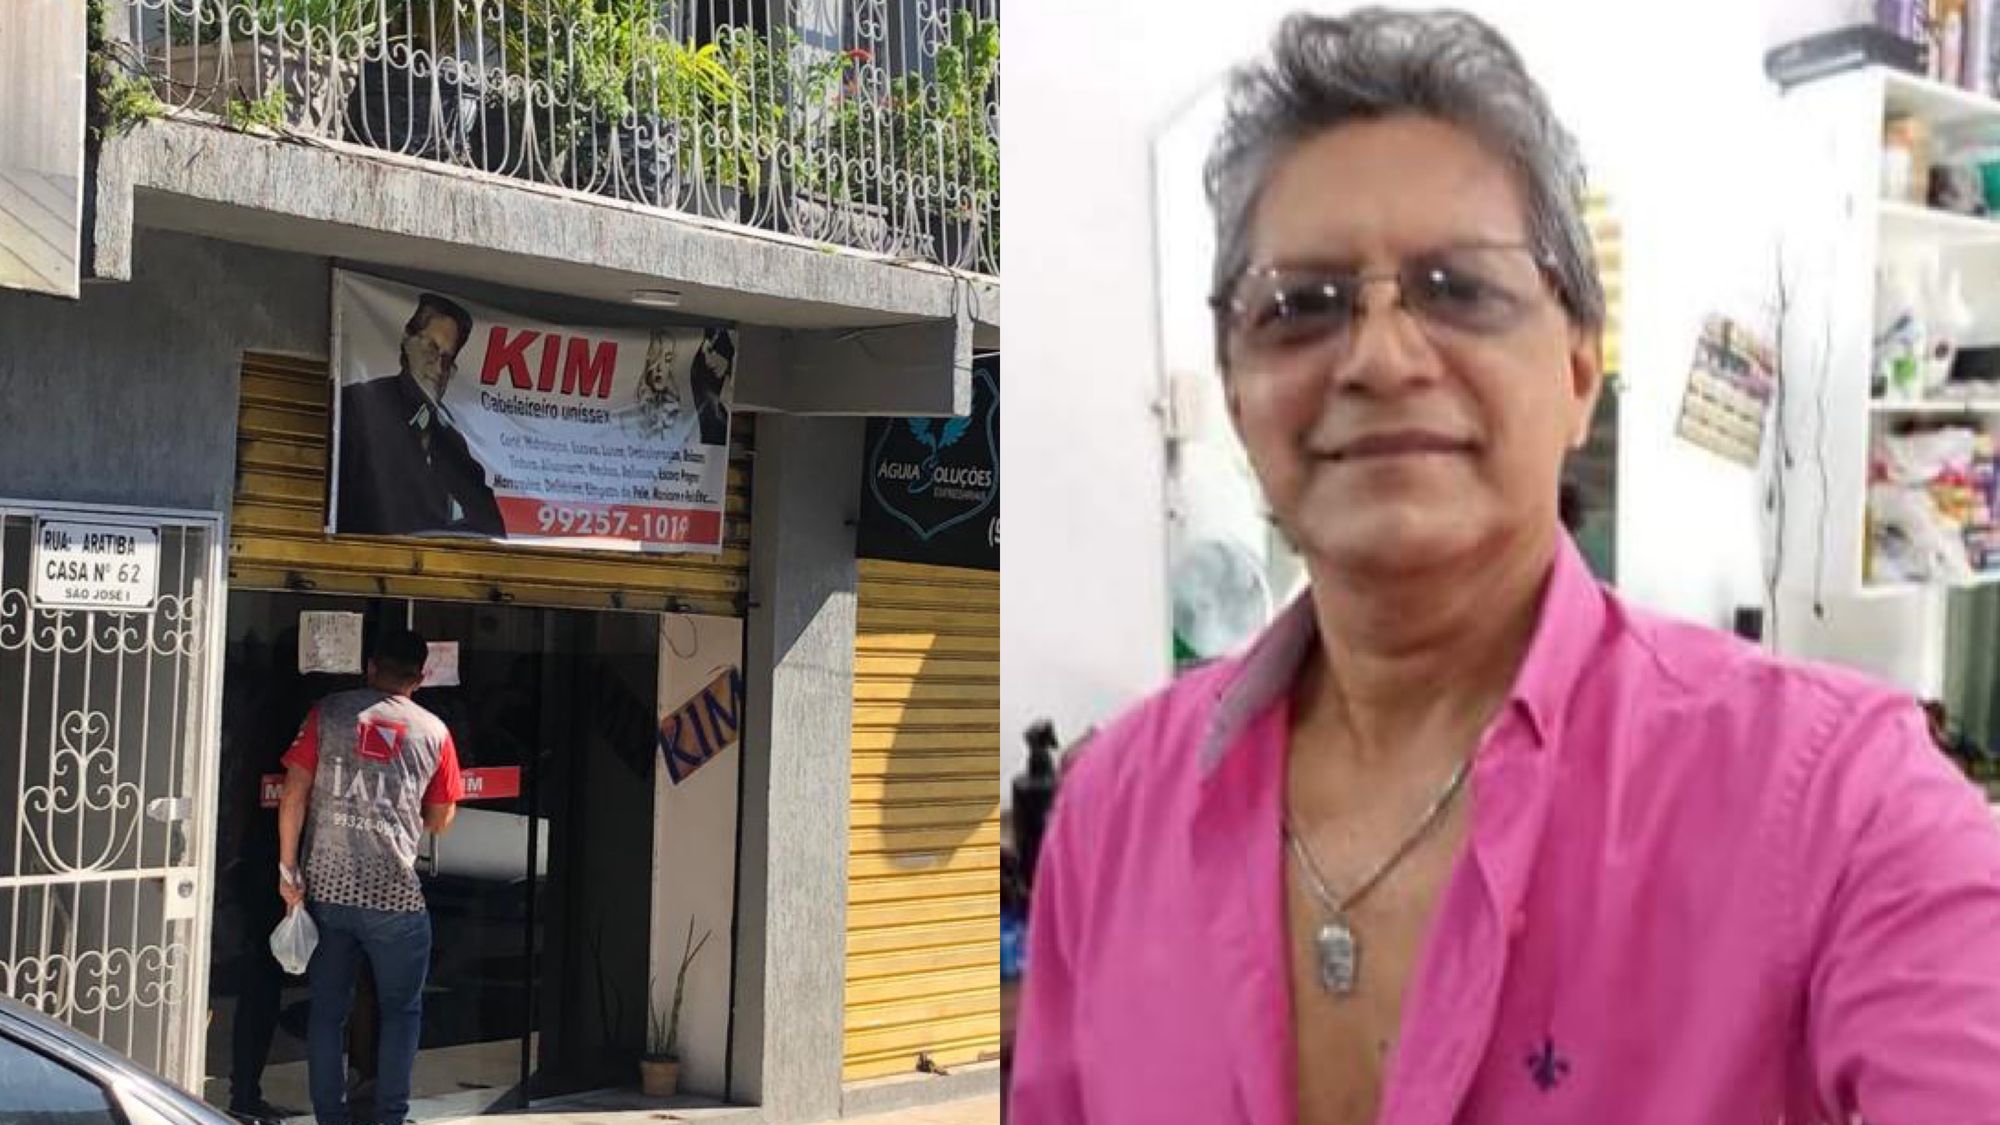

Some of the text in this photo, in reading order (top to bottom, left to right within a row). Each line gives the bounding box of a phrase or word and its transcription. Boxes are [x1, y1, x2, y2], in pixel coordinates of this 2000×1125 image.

[480, 325, 618, 399] KIM
[481, 391, 557, 418] Cabeleireiro
[83, 532, 135, 555] ARATIBA
[46, 560, 88, 581] CASA
[118, 564, 141, 583] 62
[659, 665, 742, 785] KIM
